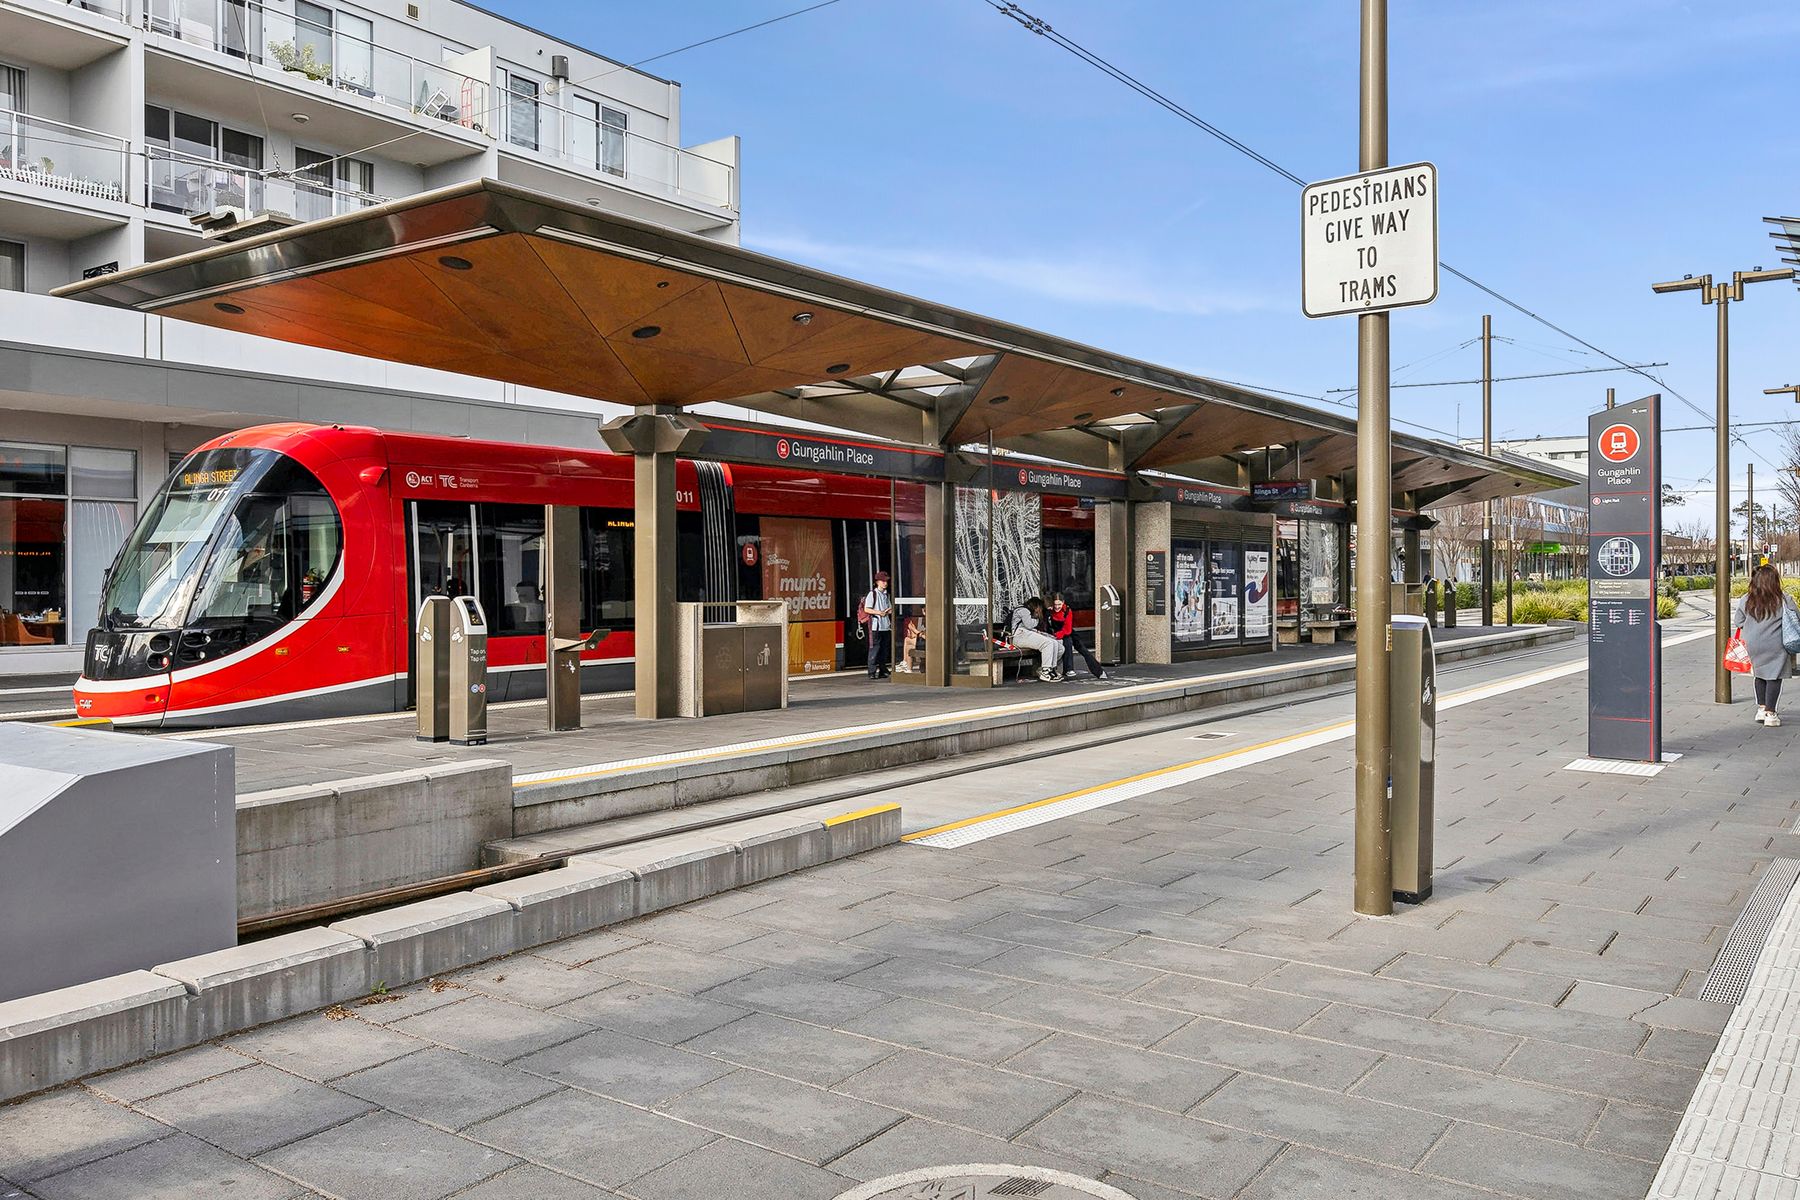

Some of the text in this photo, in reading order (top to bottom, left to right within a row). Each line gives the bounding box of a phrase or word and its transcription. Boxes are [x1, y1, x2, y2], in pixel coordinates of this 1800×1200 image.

[1309, 174, 1426, 216] PEDESTRIANS
[1325, 208, 1409, 245] GIVE WAY
[1357, 246, 1377, 269] TO
[1339, 274, 1396, 303] TRAMS
[792, 441, 874, 465] Gungahlin Place
[184, 469, 239, 485] ALINGA STREET
[421, 475, 433, 484] ACT
[1028, 471, 1082, 488] Gungahlin Place
[1598, 467, 1641, 478] Gungahlin
[1607, 477, 1632, 486] Place
[207, 488, 230, 501] 011
[676, 490, 693, 503] 011
[1184, 489, 1222, 504] Gungahlin Place
[768, 591, 832, 615] aghetti
